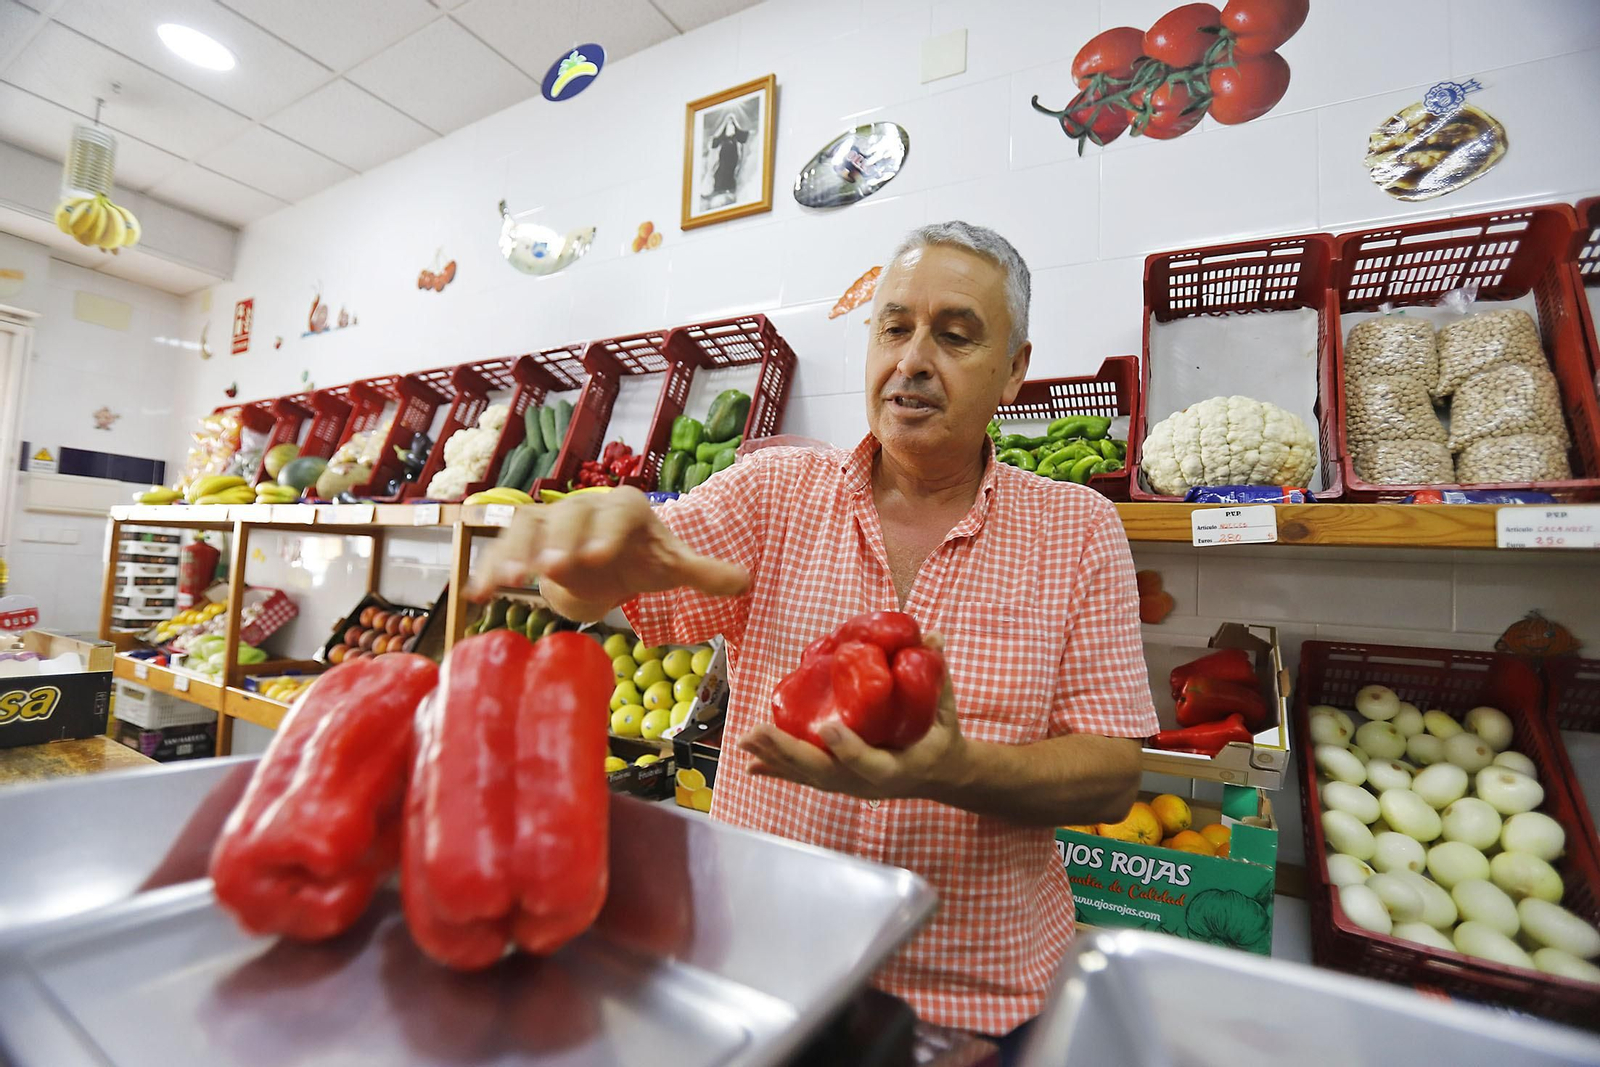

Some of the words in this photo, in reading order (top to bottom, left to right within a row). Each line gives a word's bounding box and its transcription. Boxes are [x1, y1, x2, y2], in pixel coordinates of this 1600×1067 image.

[0, 686, 61, 724] sa
[1110, 851, 1193, 886] ROJAS
[1073, 894, 1161, 921] ww.ajosrojas.com
[1108, 880, 1124, 894] de
[1128, 884, 1187, 907] Calidad
